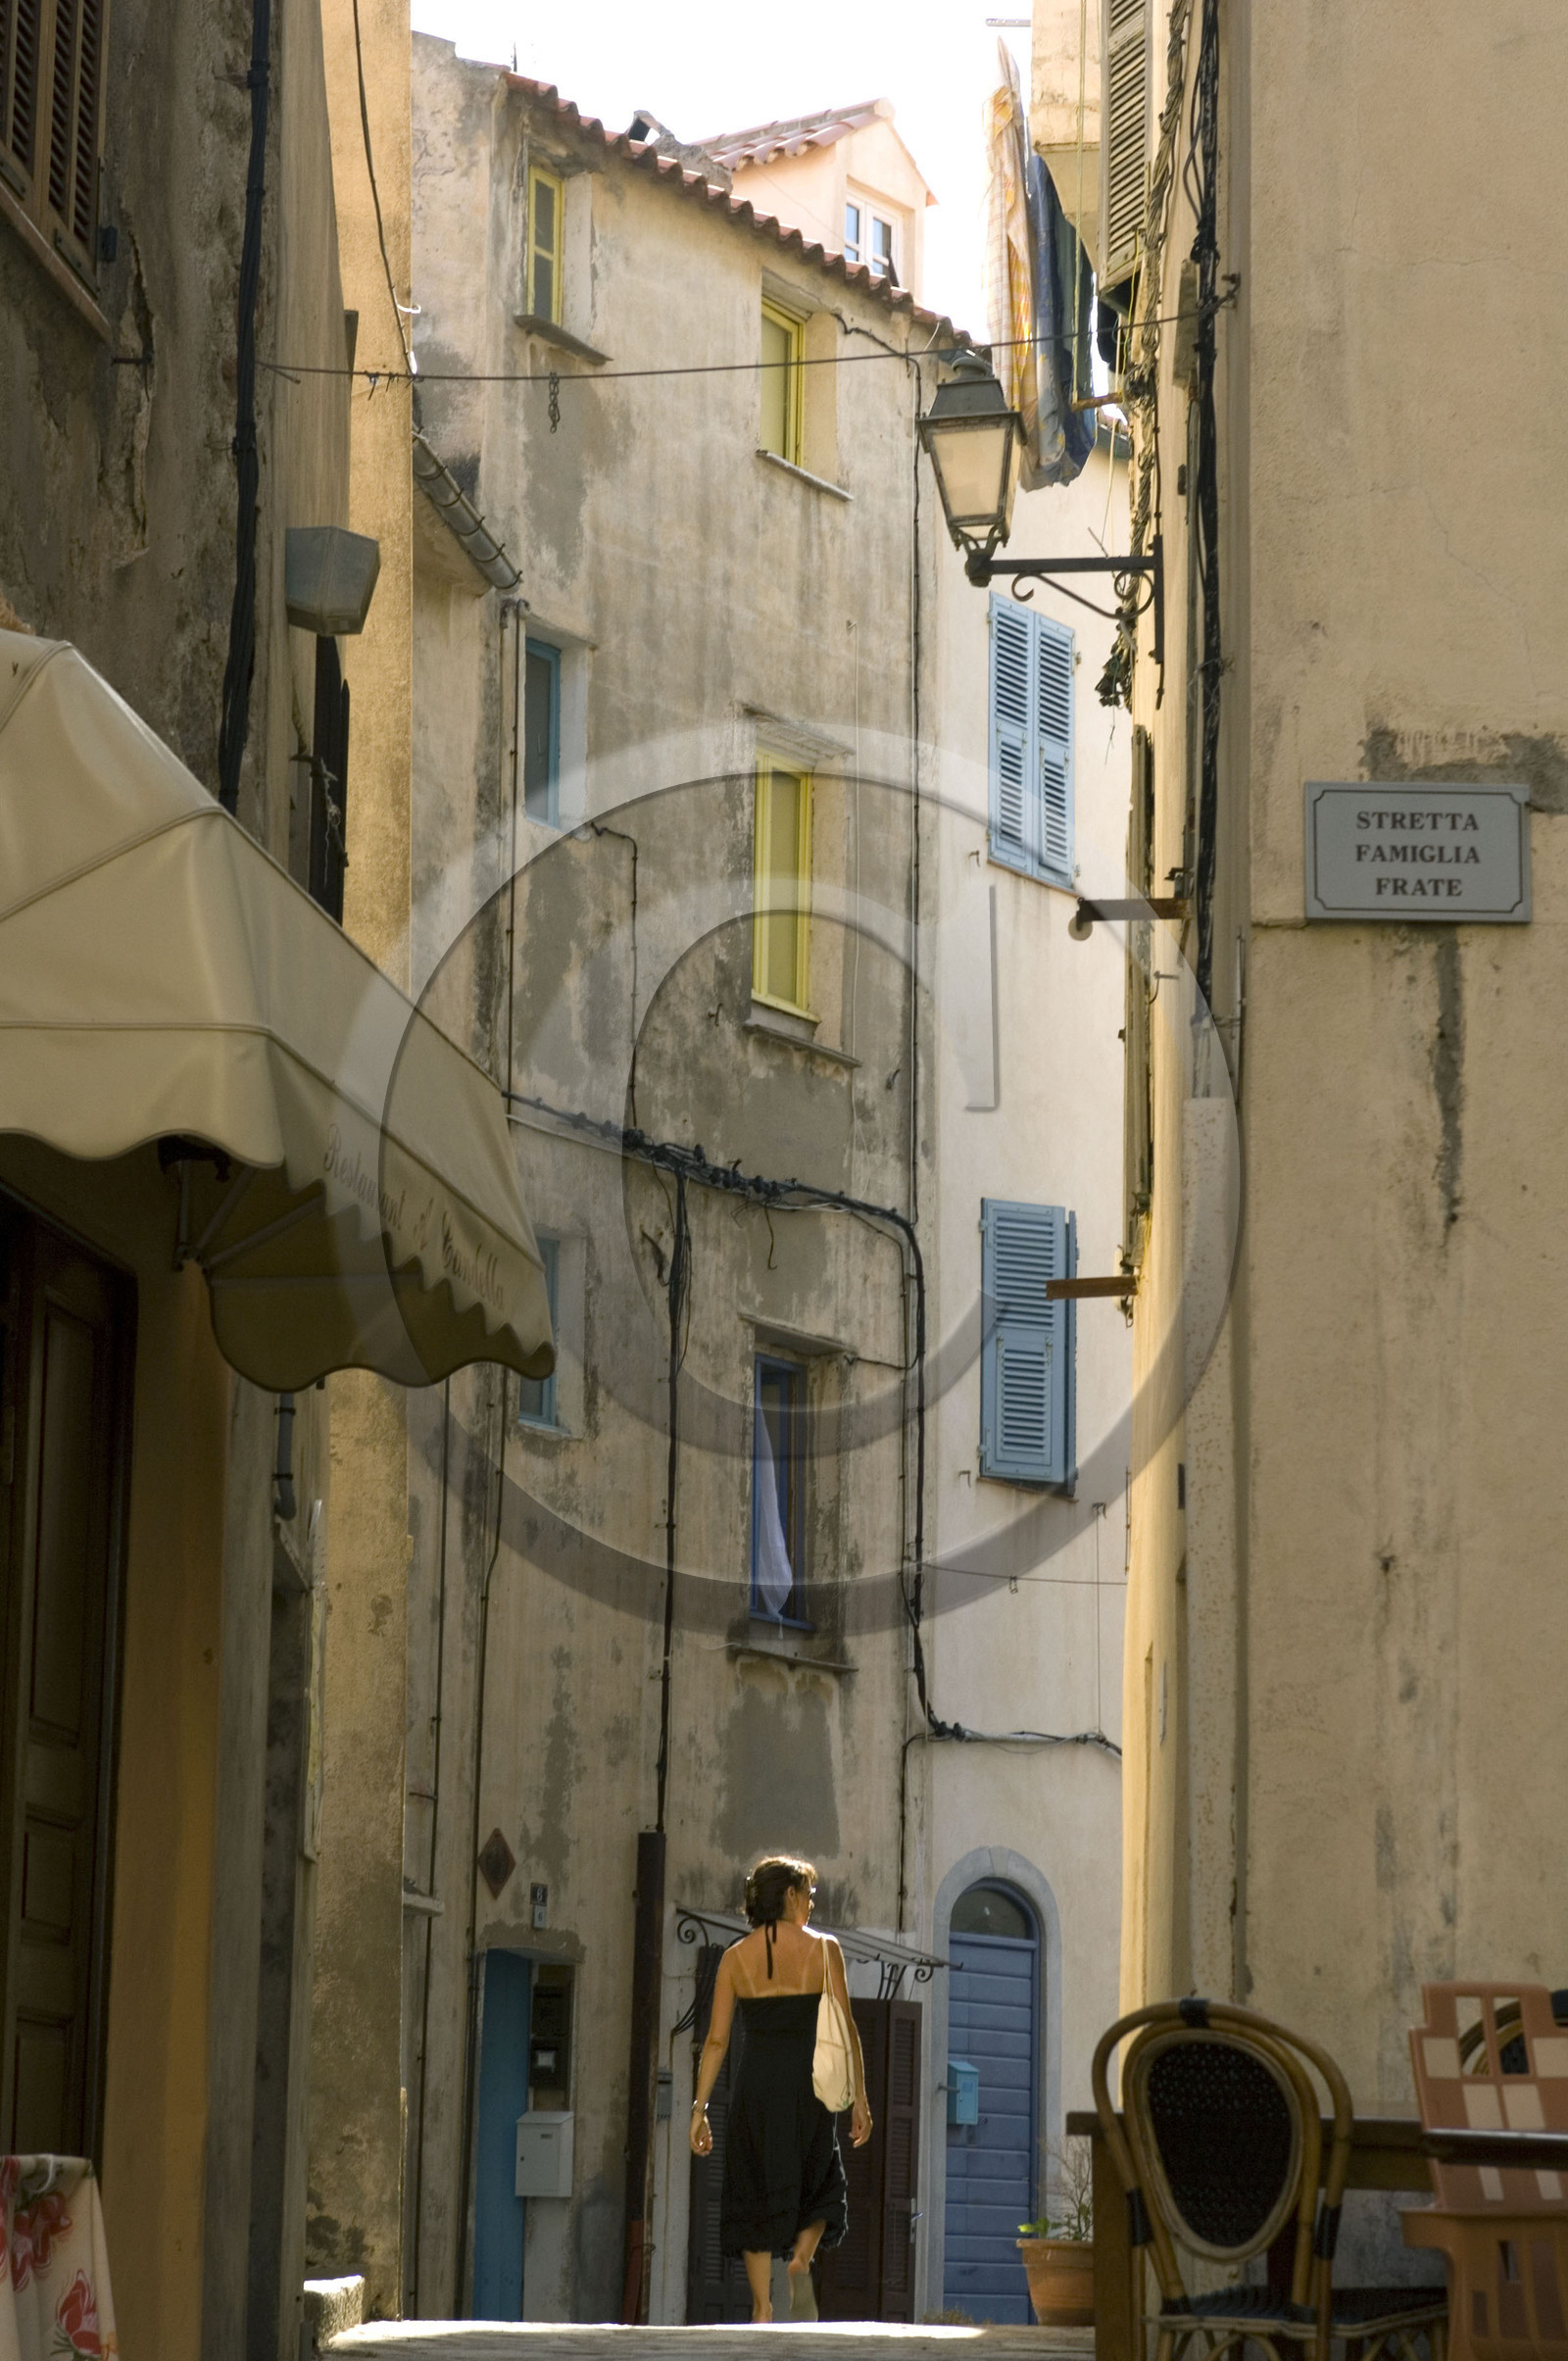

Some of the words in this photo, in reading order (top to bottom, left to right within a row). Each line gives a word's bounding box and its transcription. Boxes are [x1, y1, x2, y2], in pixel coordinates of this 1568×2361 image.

[1356, 811, 1480, 831] STRETTA
[1356, 844, 1481, 863] FAMIGLIA
[1375, 878, 1463, 897] FRATE
